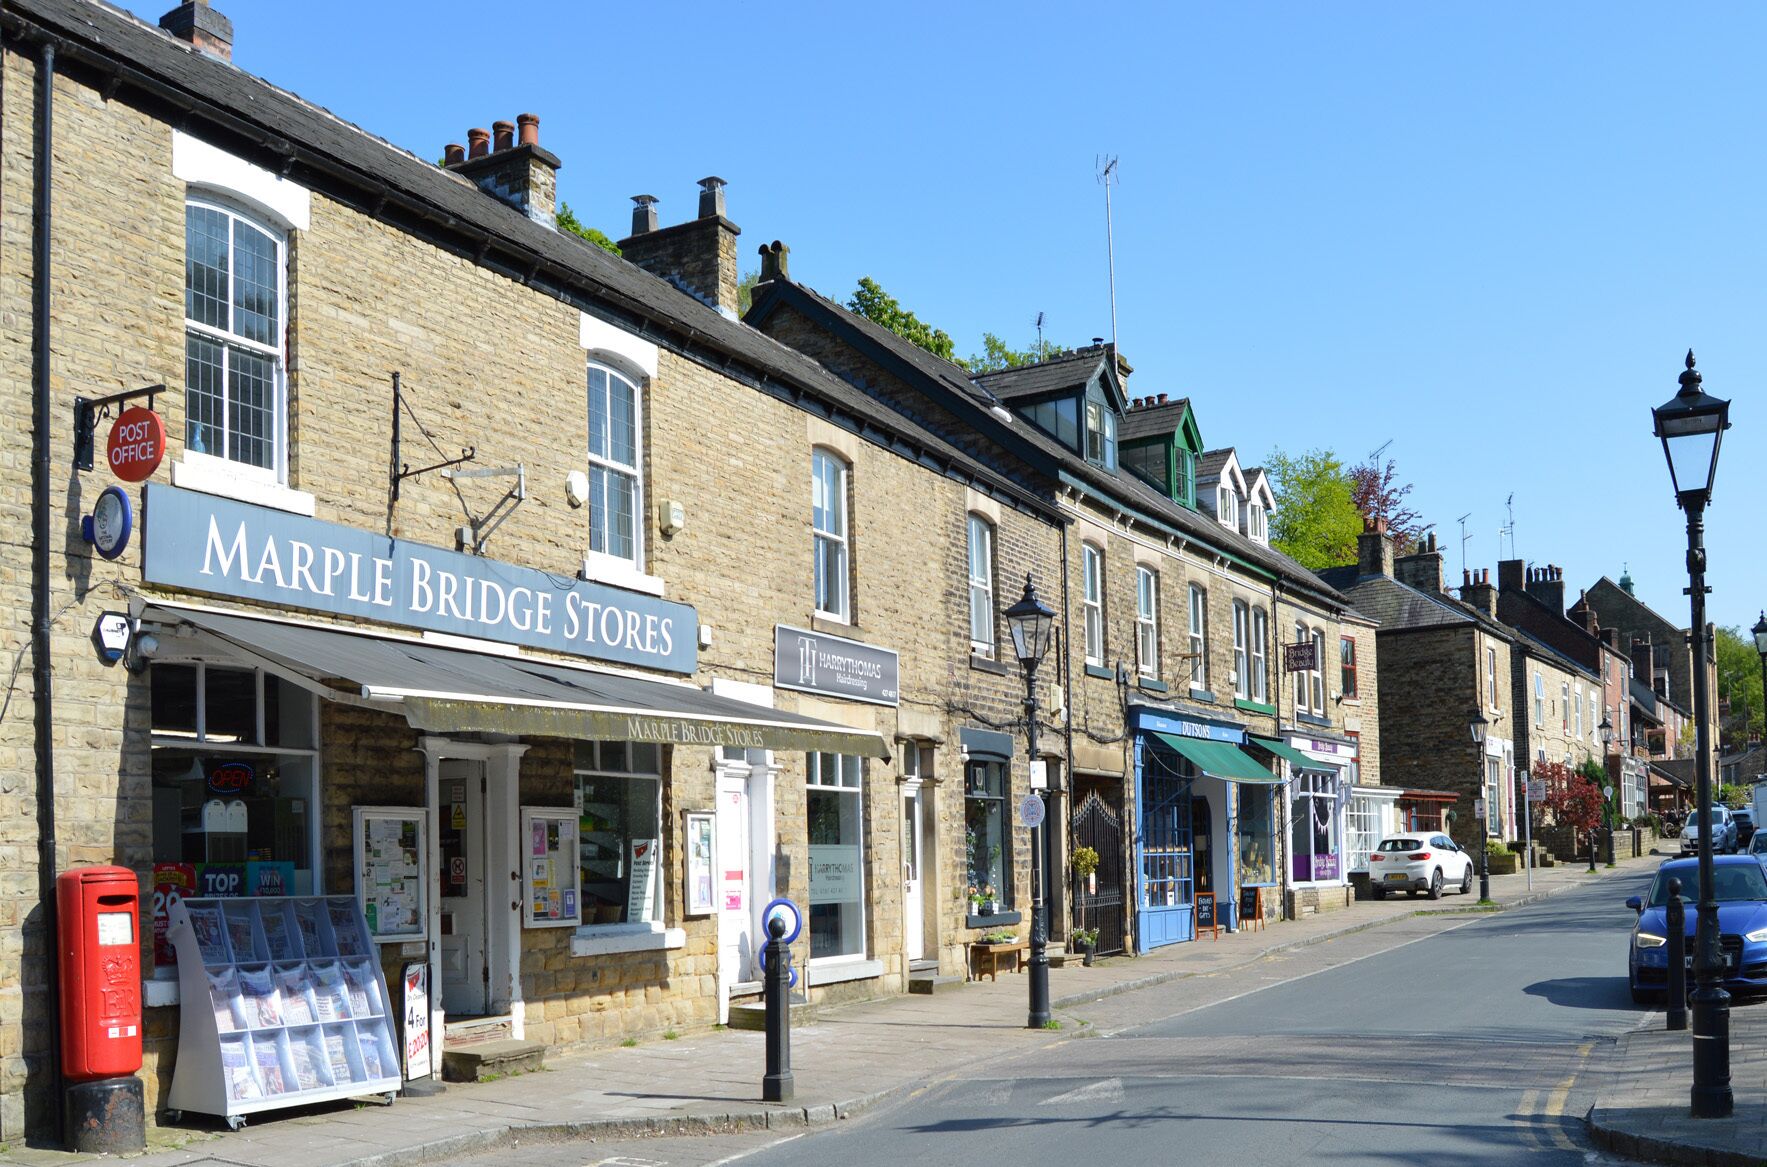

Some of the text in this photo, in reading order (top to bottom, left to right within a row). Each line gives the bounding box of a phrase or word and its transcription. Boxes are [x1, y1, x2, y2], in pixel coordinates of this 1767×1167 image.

[119, 421, 150, 443] POST
[112, 441, 154, 465] OFFICE
[200, 513, 673, 656] MARPLE BRIDGE STORES
[1288, 648, 1313, 659] Bridge
[819, 652, 881, 679] HARRYTHOMAS
[1289, 659, 1314, 670] Beauty
[836, 673, 868, 691] Hairdressing
[627, 716, 764, 747] MARPLE BRIDGE STORES
[1182, 721, 1211, 739] DUTSONS
[211, 769, 250, 788] OPEN
[205, 873, 239, 892] TOP
[260, 875, 281, 887] WIN
[407, 1006, 426, 1029] 4 For
